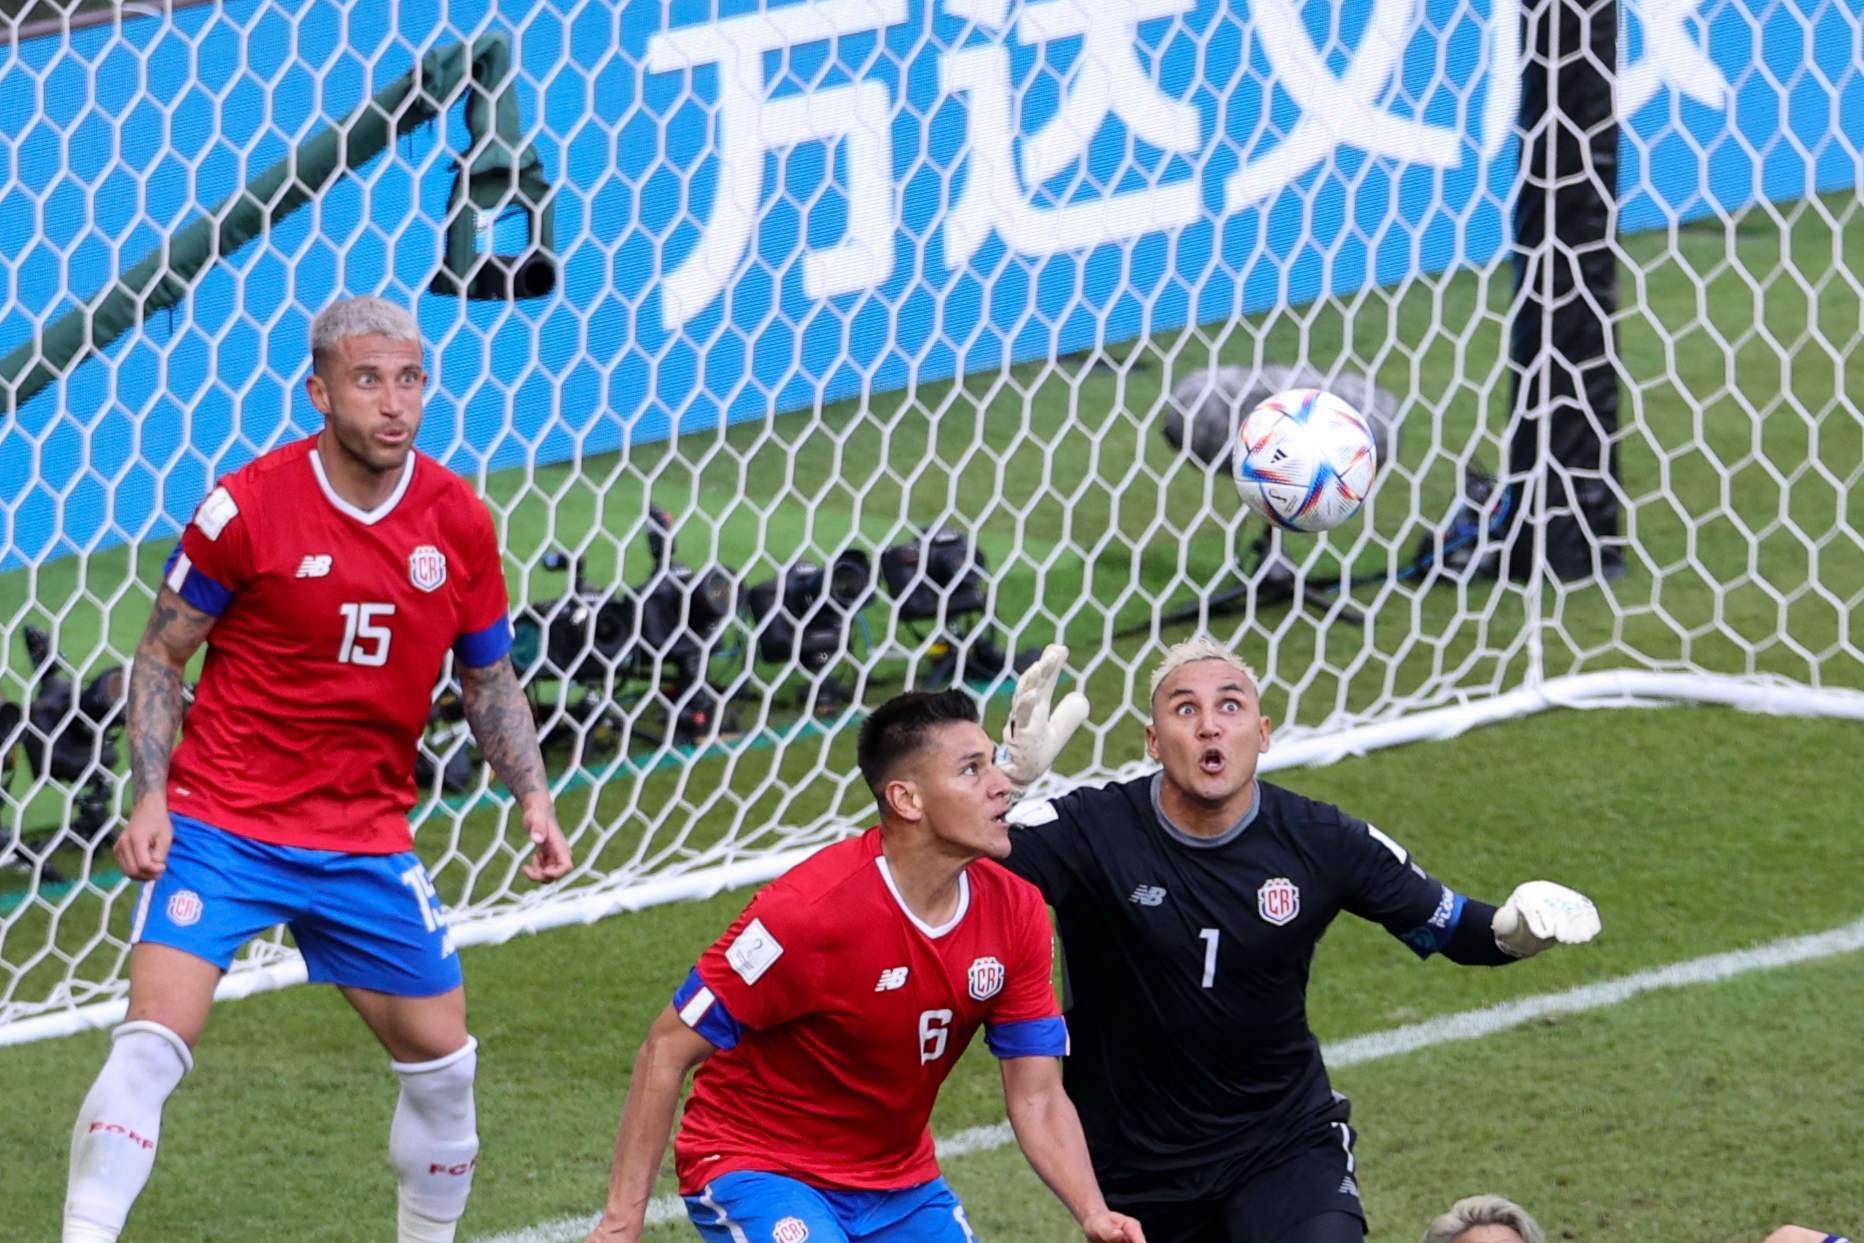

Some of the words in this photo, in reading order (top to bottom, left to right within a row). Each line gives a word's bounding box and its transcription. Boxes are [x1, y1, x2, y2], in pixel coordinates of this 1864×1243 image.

[337, 603, 396, 667] 15
[1199, 928, 1220, 988] 1
[919, 1008, 953, 1066] 6
